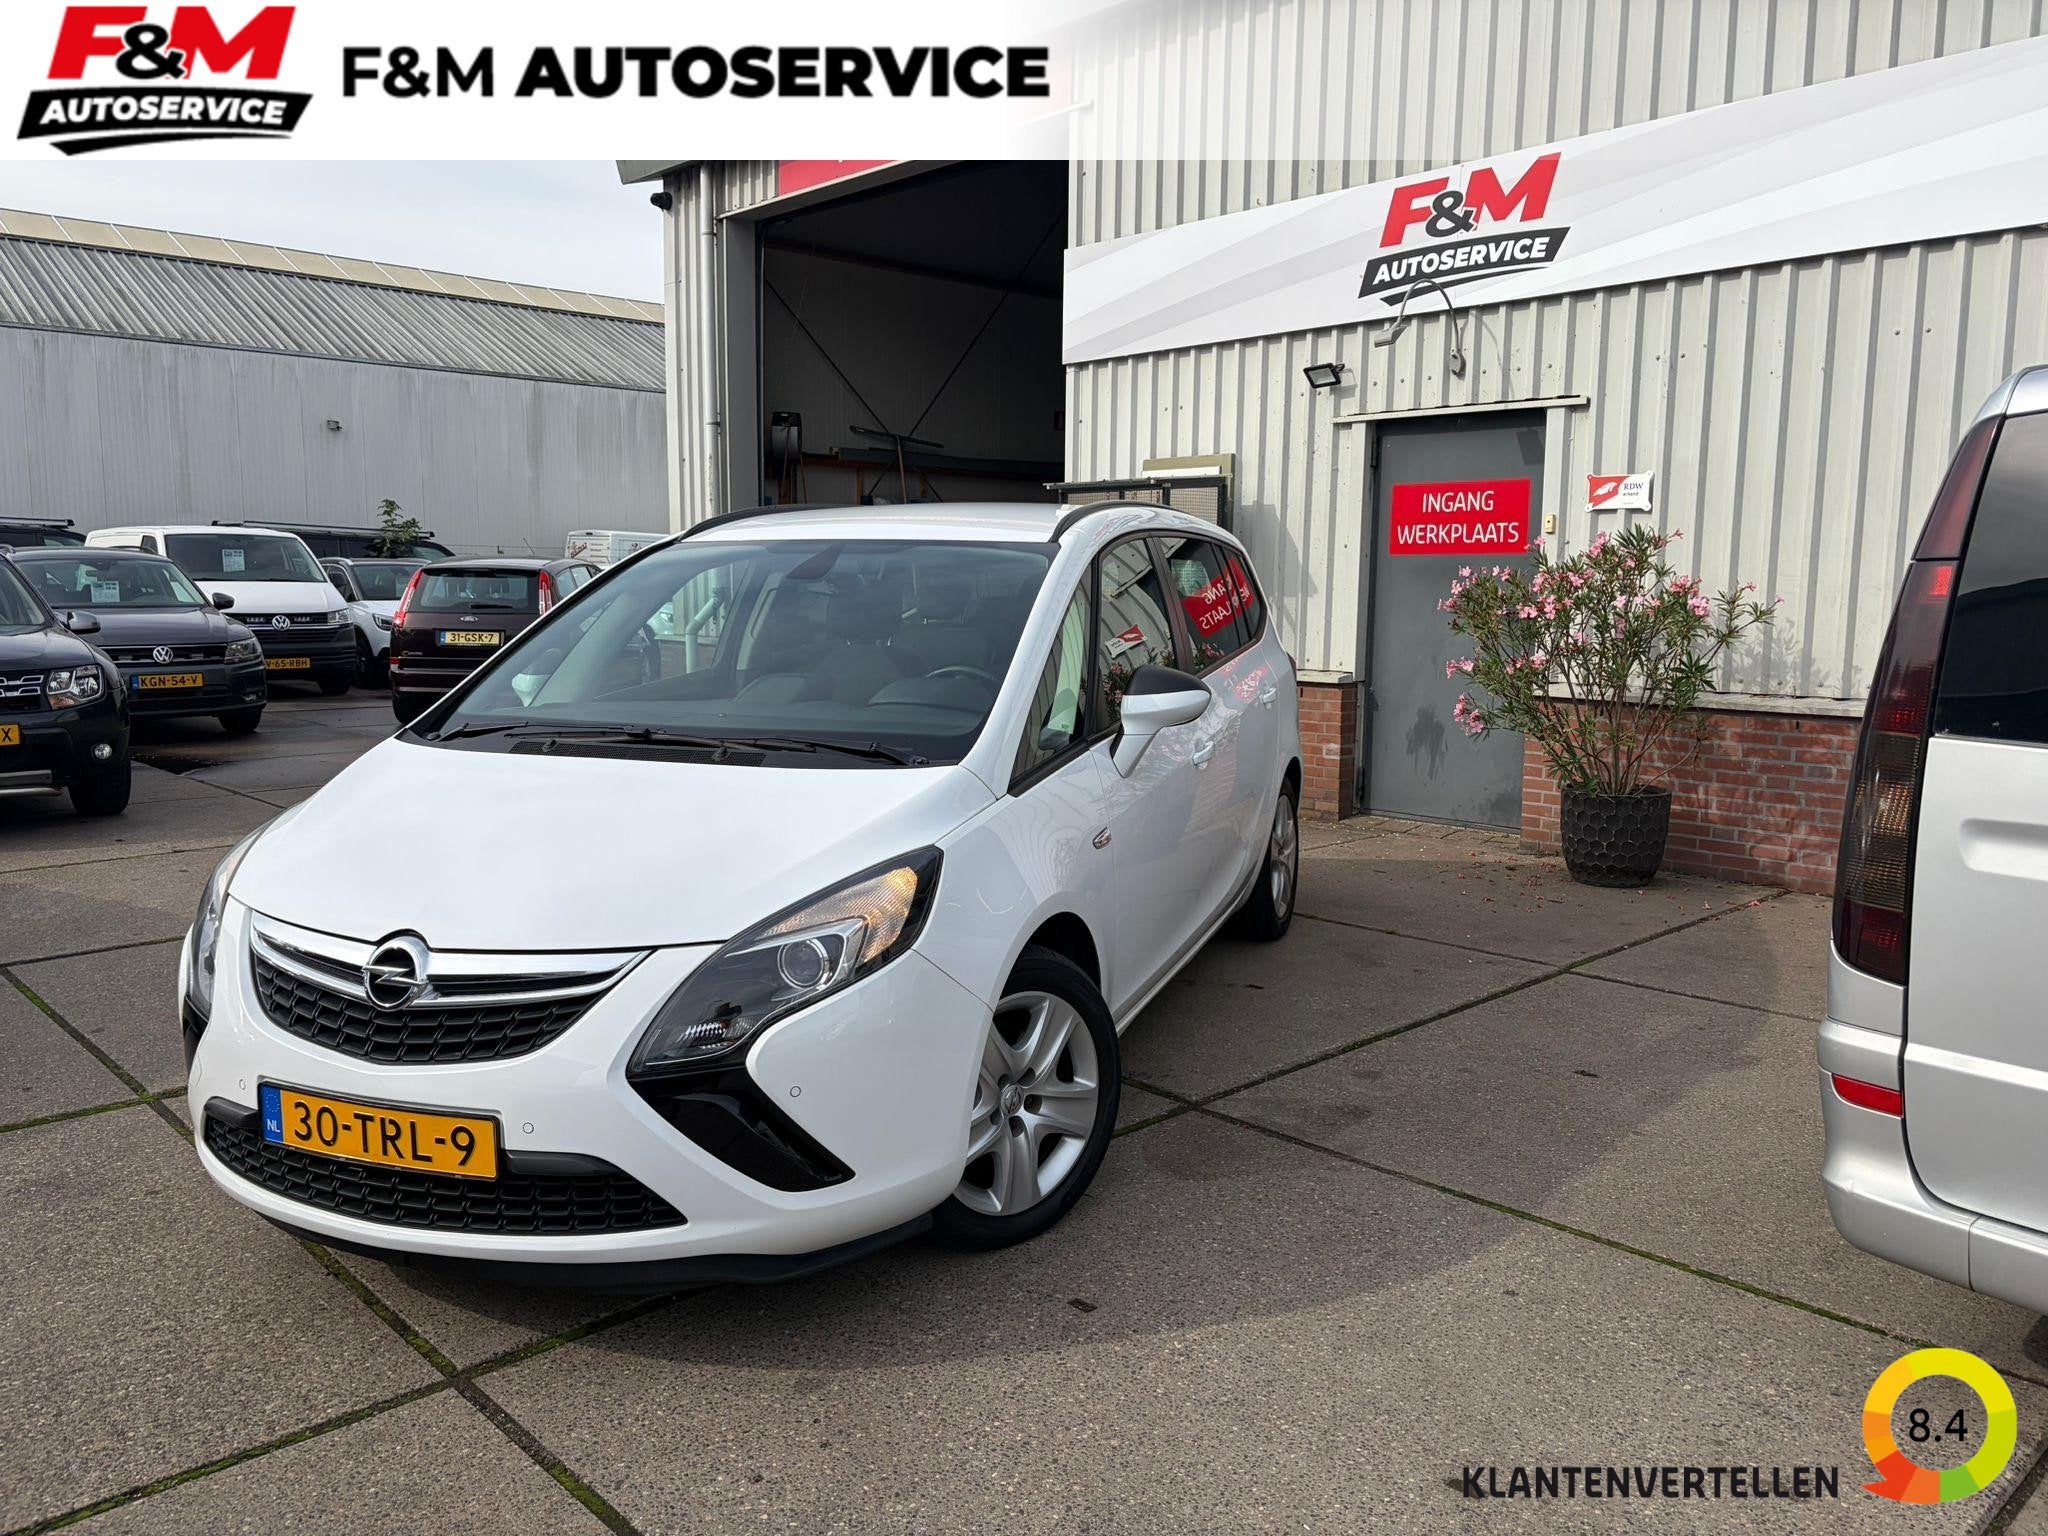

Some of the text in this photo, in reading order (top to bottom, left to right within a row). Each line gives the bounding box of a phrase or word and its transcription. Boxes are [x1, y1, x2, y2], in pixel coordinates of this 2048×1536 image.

[1379, 152, 1562, 249] F&M
[1372, 236, 1551, 286] AUTOSERVICE
[1623, 482, 1644, 491] RDW
[1422, 490, 1495, 513] INGANG
[1397, 522, 1520, 545] WERKPLAATS
[140, 675, 199, 688] KGN-54-V
[266, 1100, 477, 1167] NL 30-TRL-9
